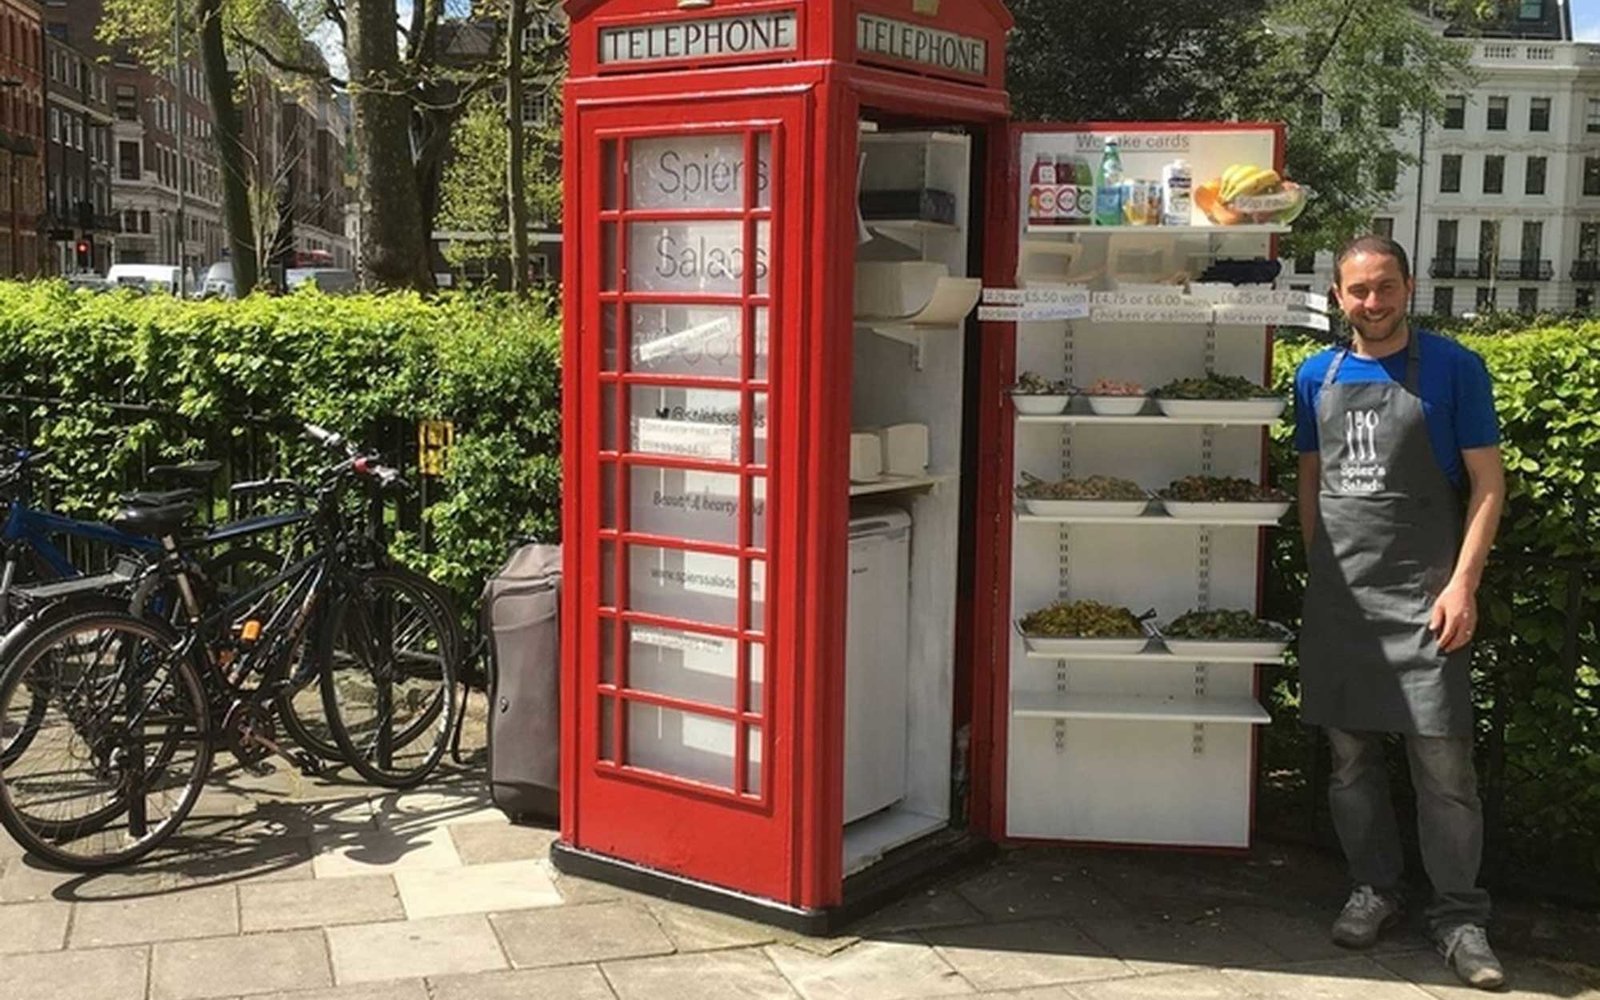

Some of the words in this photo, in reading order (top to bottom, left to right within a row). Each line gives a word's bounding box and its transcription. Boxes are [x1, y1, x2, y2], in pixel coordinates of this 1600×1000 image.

[605, 16, 790, 60] TELEPHONE
[860, 16, 981, 73] TELEPHONE
[1146, 133, 1190, 148] cards
[659, 151, 768, 201] Spiers
